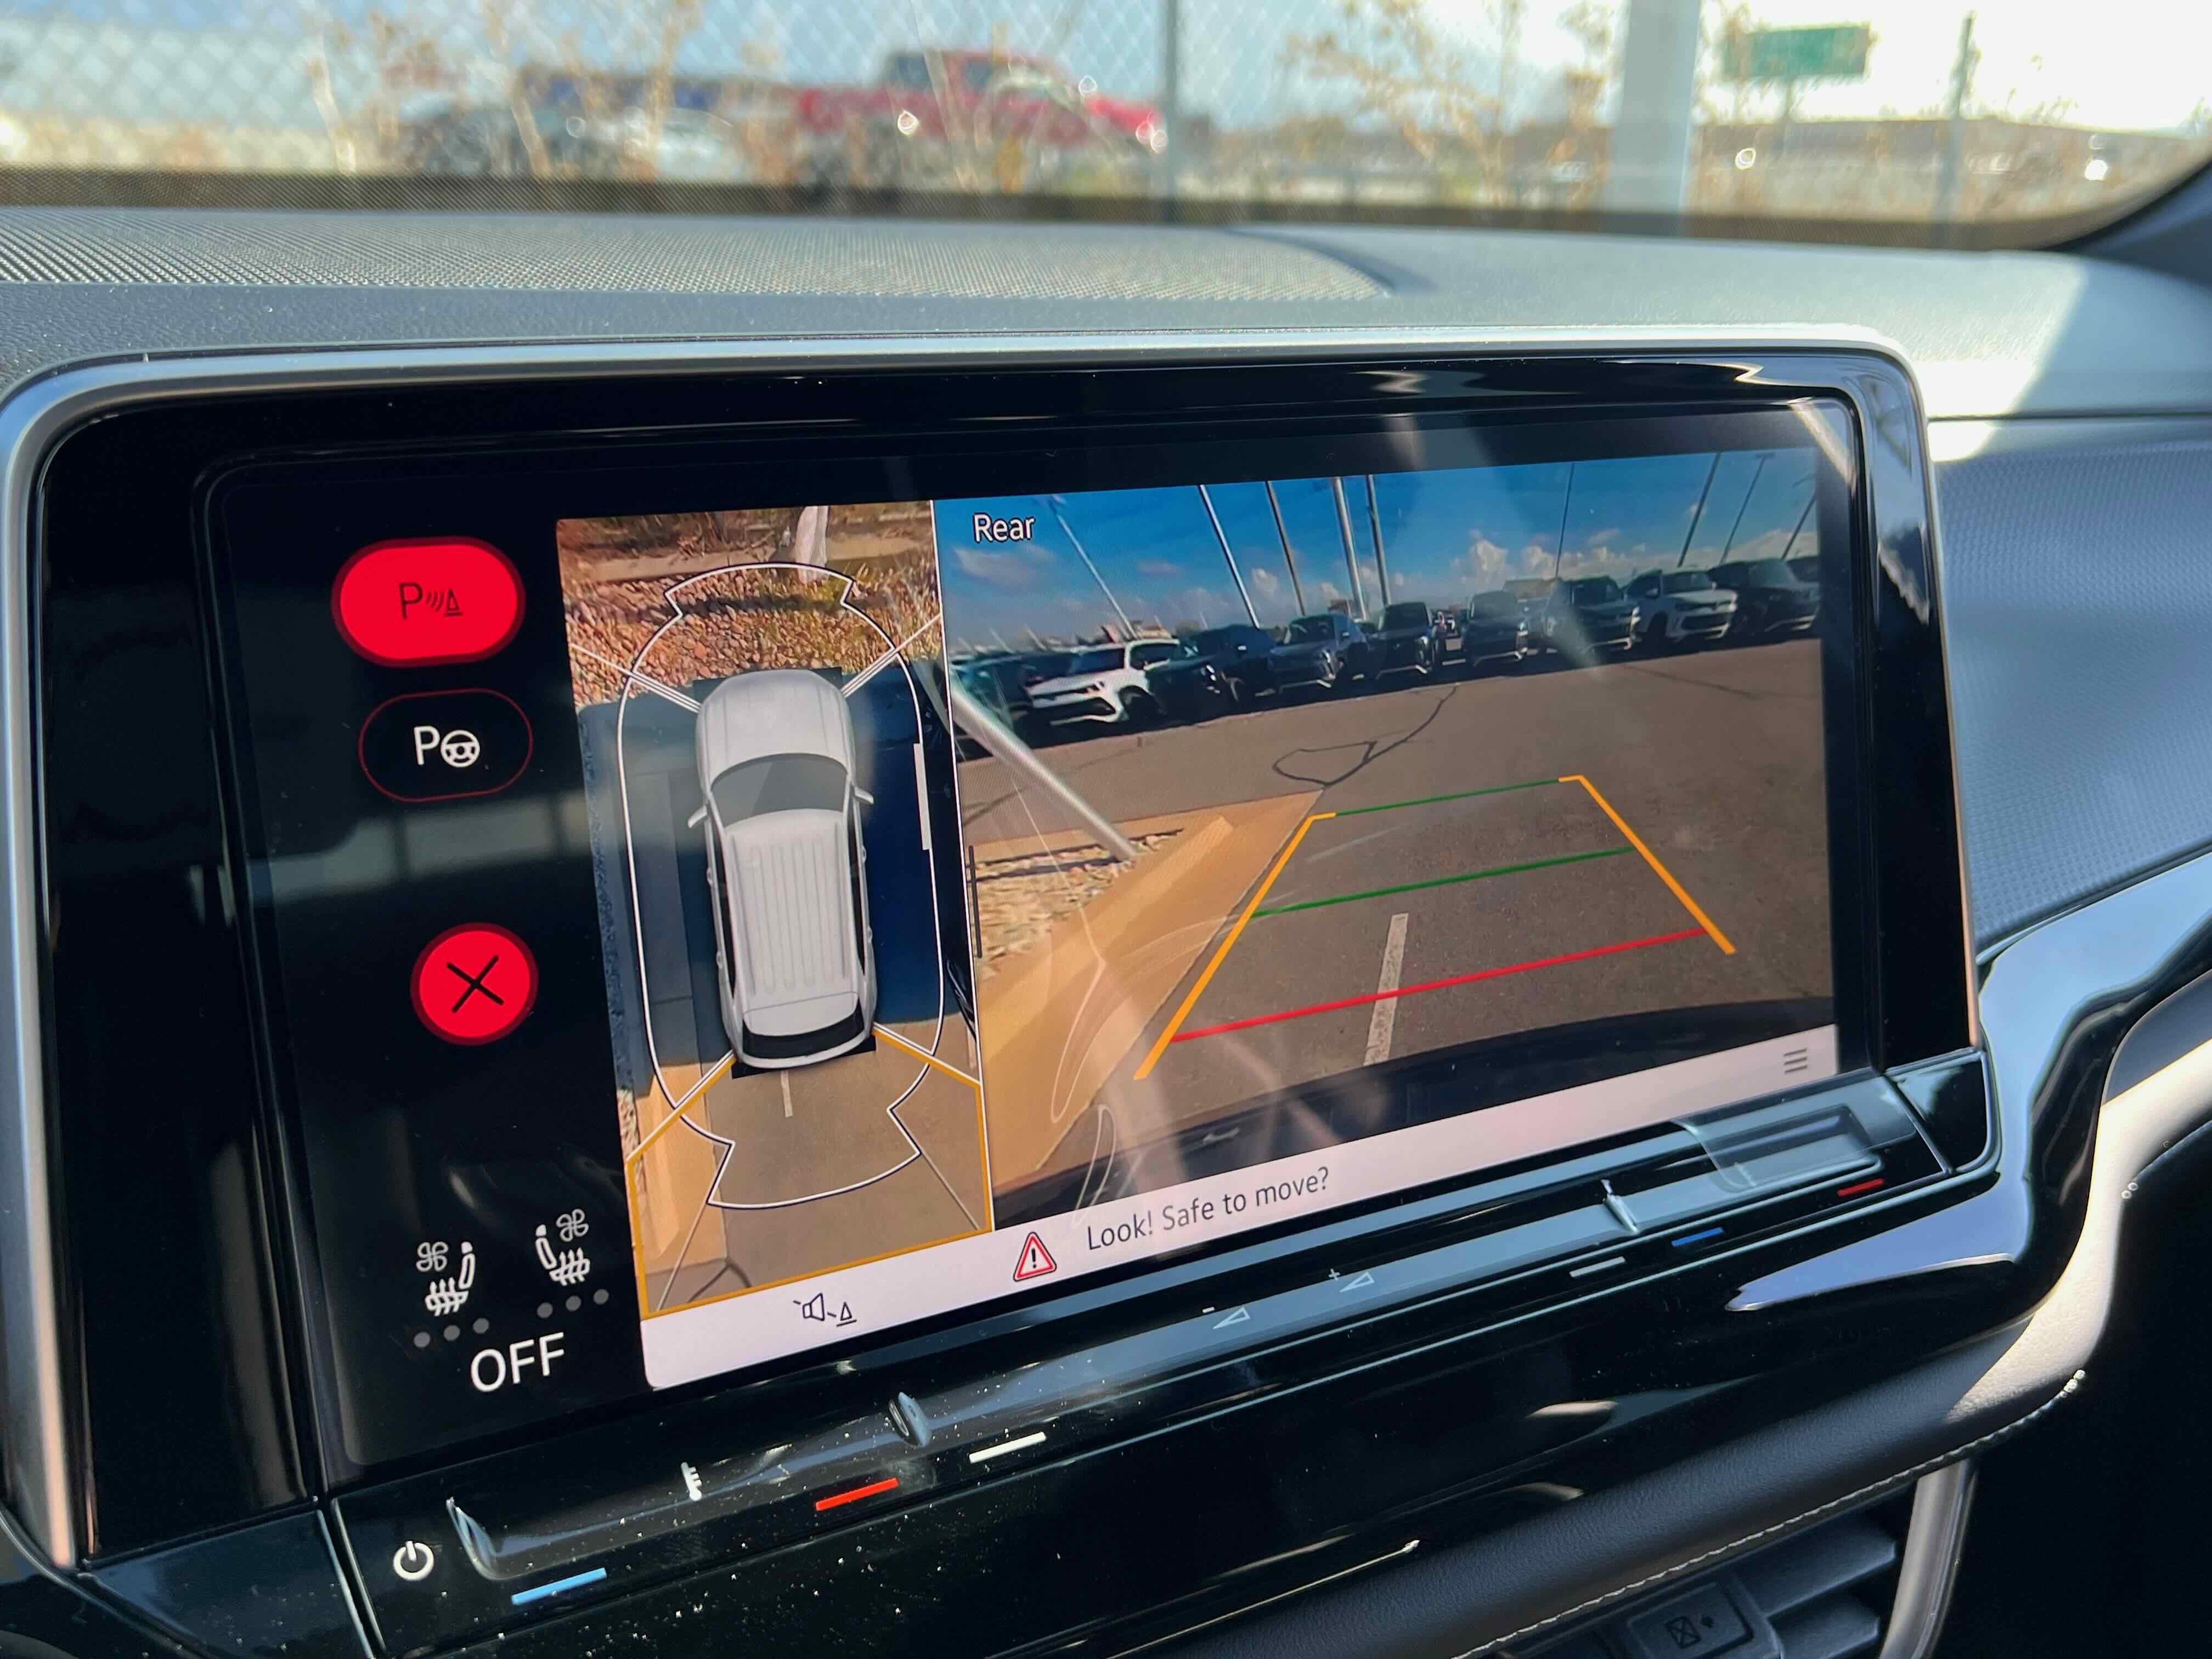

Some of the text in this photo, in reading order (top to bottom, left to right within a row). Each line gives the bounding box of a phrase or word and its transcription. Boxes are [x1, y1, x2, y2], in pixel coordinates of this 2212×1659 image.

[973, 512, 1035, 543] Rear
[1087, 1166, 1329, 1251] Look! Safe to move?
[471, 1332, 564, 1392] OFF
